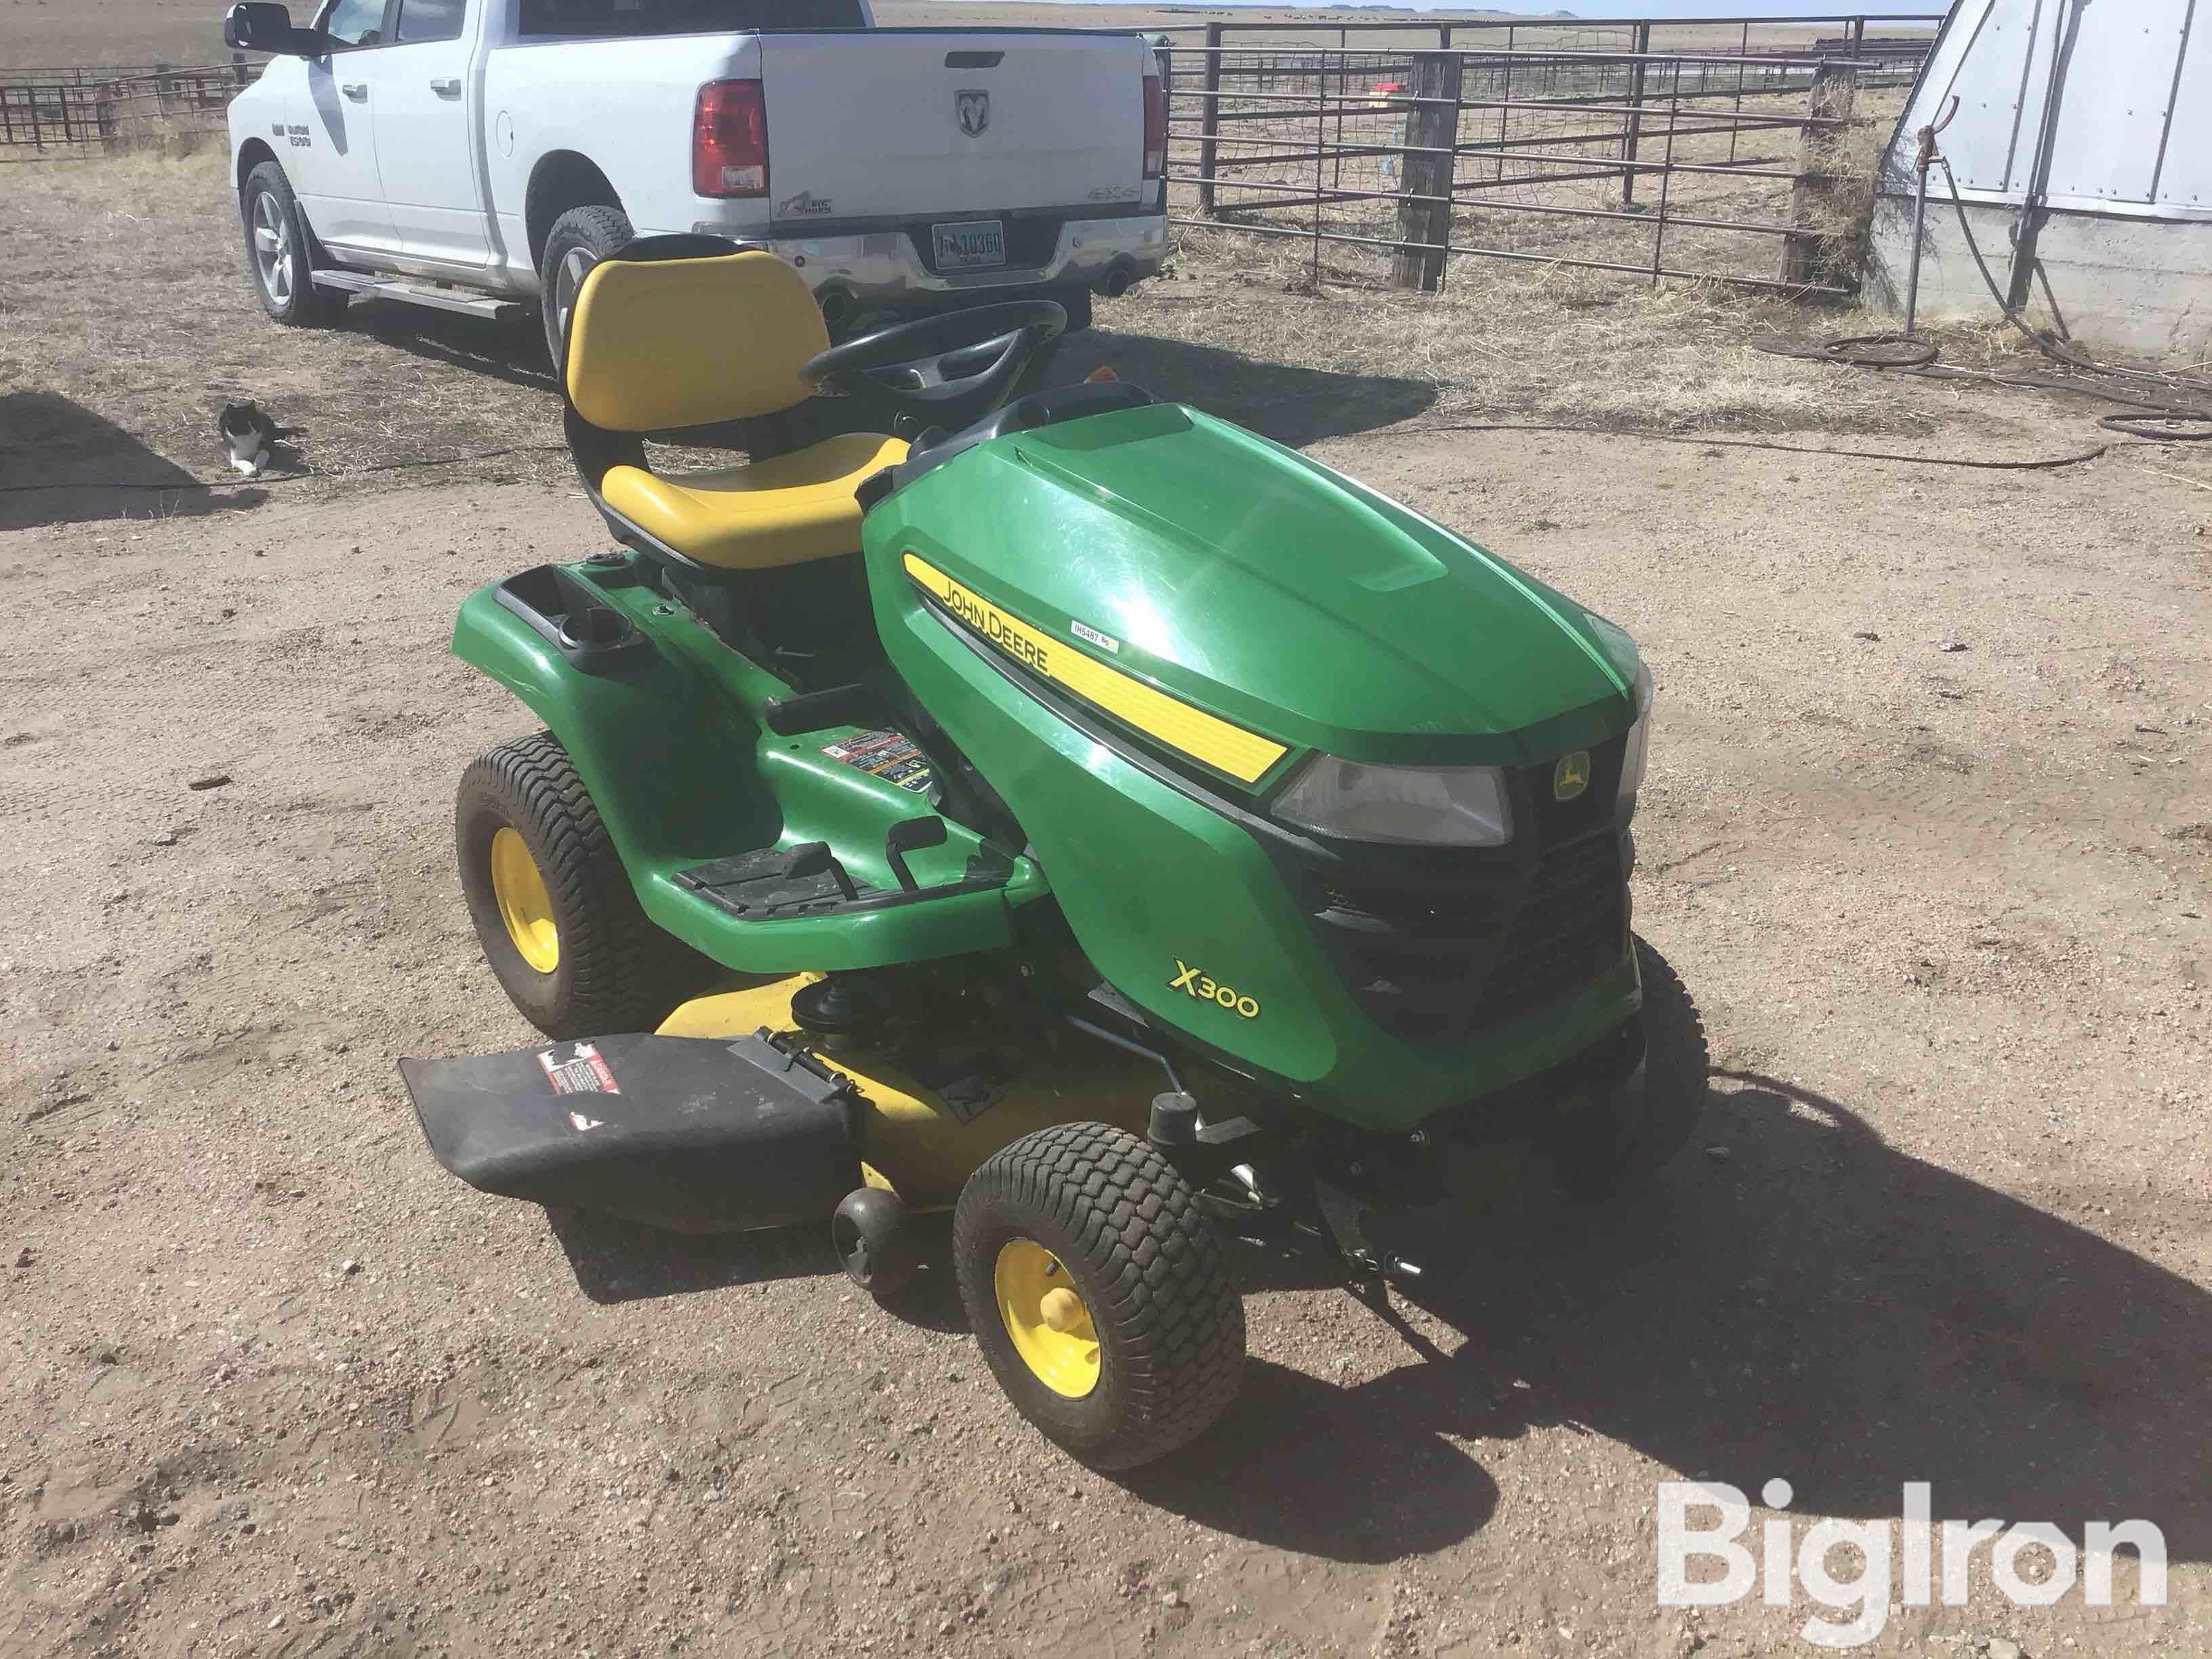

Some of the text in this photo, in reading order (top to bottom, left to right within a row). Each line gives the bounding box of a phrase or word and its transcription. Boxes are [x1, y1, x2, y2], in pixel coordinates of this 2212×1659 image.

[943, 580, 1048, 673] JOHN DEERE
[1074, 623, 1099, 642] IH5487
[1169, 958, 1259, 1018] X300
